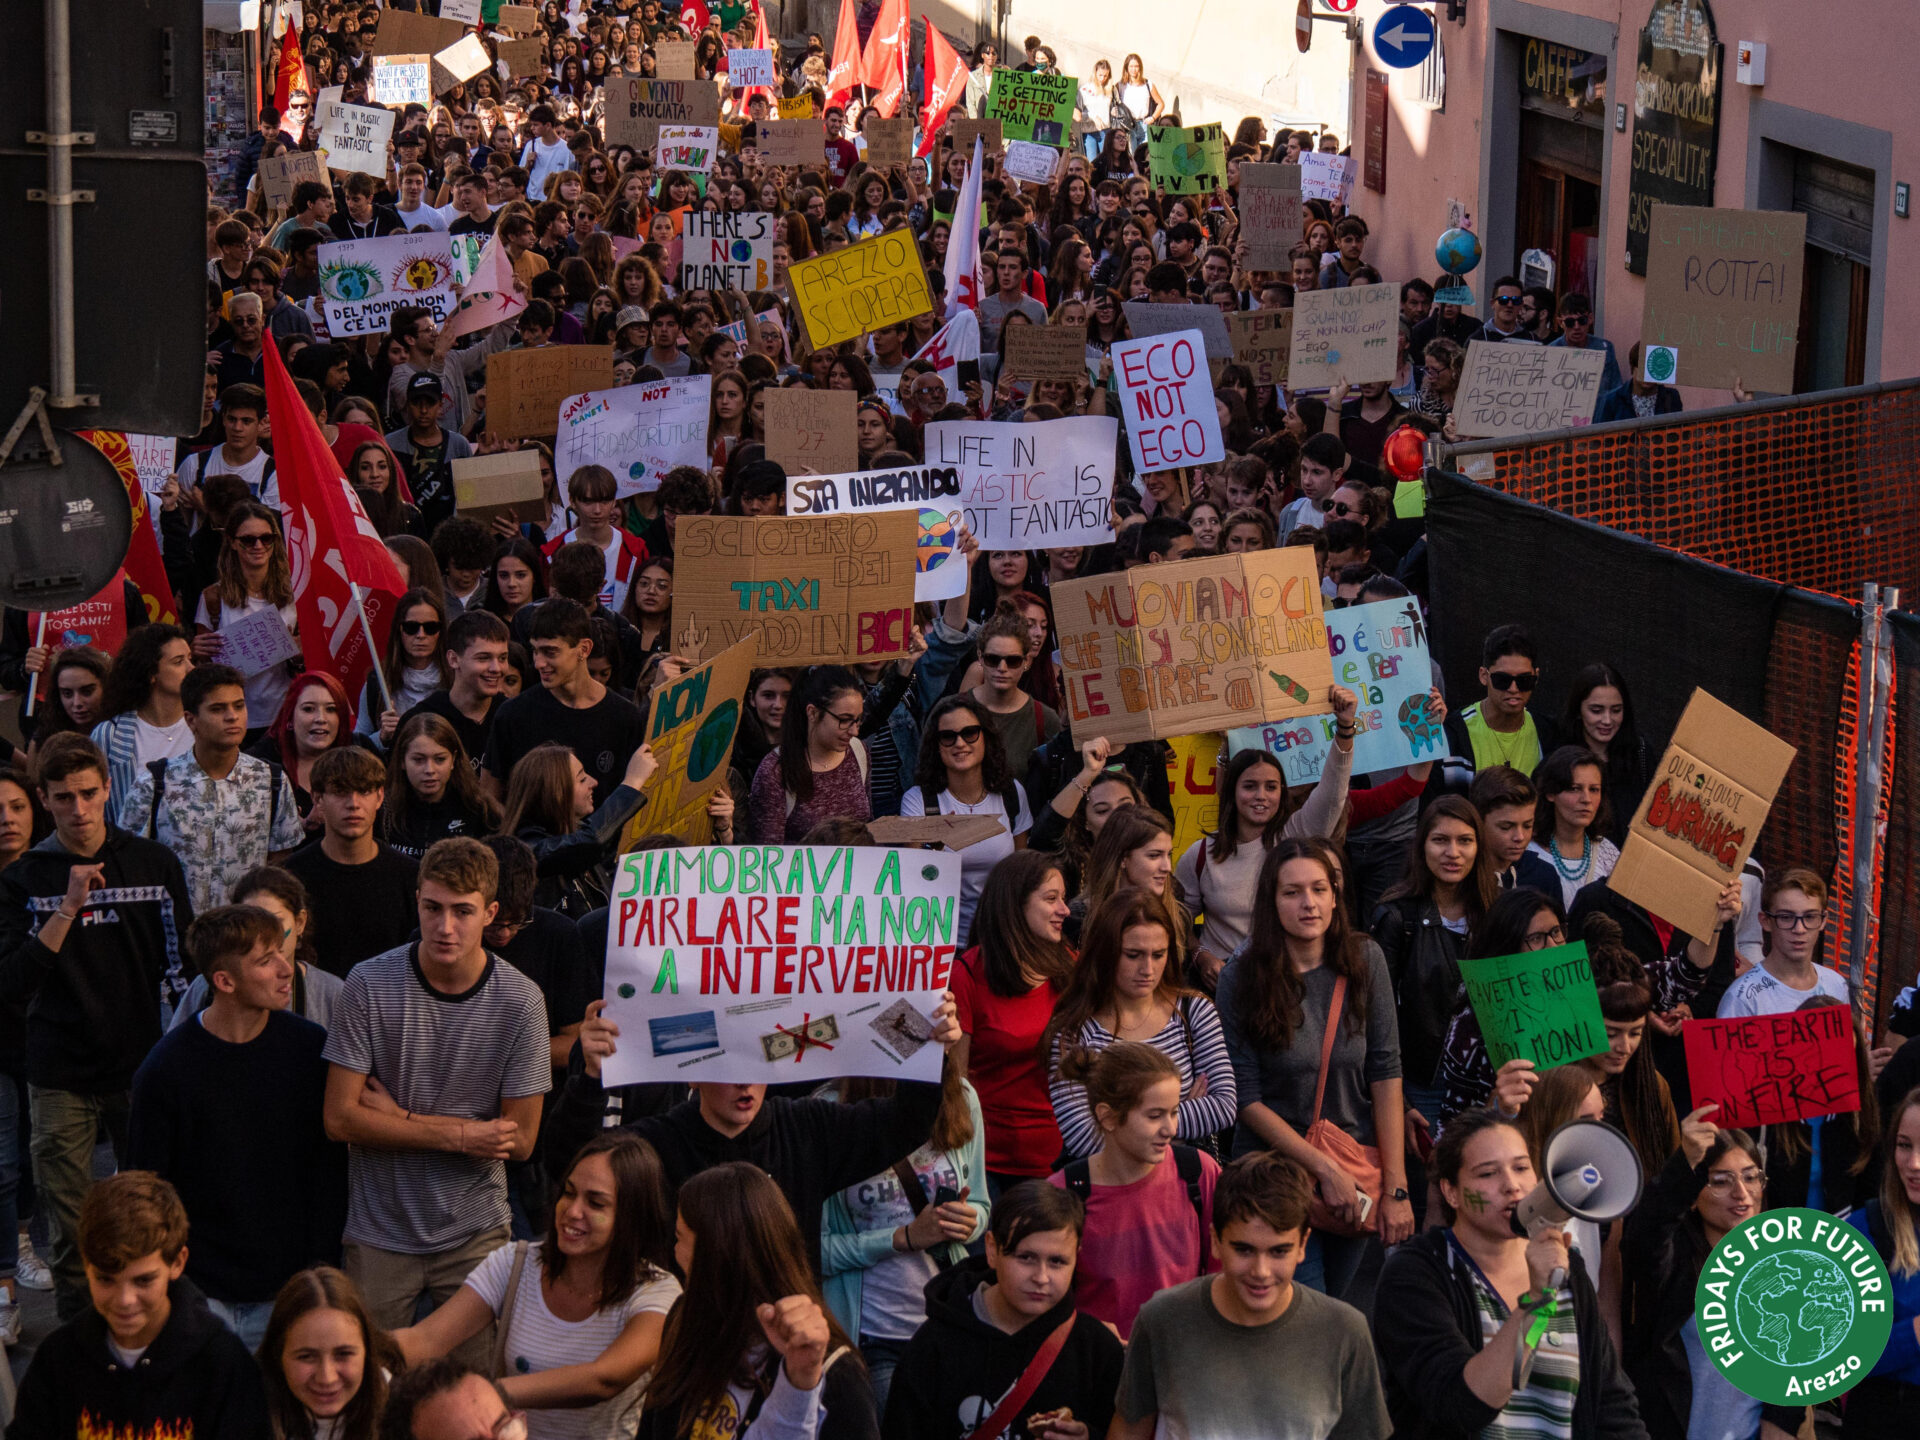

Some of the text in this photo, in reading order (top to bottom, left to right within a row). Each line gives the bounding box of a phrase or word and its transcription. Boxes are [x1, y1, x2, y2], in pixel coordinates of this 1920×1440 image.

[376, 78, 392, 88] THE
[740, 66, 758, 85] HOT
[994, 71, 1068, 88] THIS WORLD
[778, 93, 811, 111] THIS ISN'T
[998, 84, 1066, 104] IS GETTING
[330, 106, 380, 126] LIFE IN PLASTIC
[630, 102, 693, 120] BRUCIATA?
[992, 108, 1030, 126] THAN
[998, 97, 1054, 118] HOTTER
[344, 122, 372, 138] IS NOT
[334, 134, 372, 154] FANTASTIC
[662, 146, 710, 168] POLMONI
[1302, 154, 1343, 168] Ama la
[1302, 178, 1325, 186] come
[1328, 168, 1354, 184] TERRA
[404, 236, 424, 245] 2030
[684, 258, 768, 291] PLANET B
[801, 239, 905, 300] AREZZO
[1685, 256, 1785, 304] ROTTA!
[334, 294, 446, 320] DEL MONDO NON
[810, 272, 930, 346] SCIOPERA
[1302, 296, 1320, 313] SE
[1333, 290, 1362, 306] NON
[369, 305, 447, 330] LA B
[1306, 310, 1363, 326] QUANDO?
[1296, 330, 1311, 342] SE
[1316, 326, 1338, 338] NON
[1362, 320, 1386, 333] CHI?
[1120, 338, 1196, 388] ECO
[1240, 348, 1290, 363] NOSTR
[1480, 350, 1548, 368] ASCOLTA
[1557, 354, 1576, 370] IL
[1476, 366, 1598, 391] PIANETA COME
[564, 392, 591, 421] SAVE
[642, 386, 688, 402] NOT THE
[1136, 381, 1187, 421] NOT
[1467, 388, 1582, 408] ASCOLTI IL
[570, 400, 610, 428] PLANET!
[1472, 408, 1574, 430] TUO CUORE
[797, 430, 825, 450] 27
[940, 430, 1035, 468] LIFE IN
[1138, 420, 1206, 468] EGO
[1074, 464, 1102, 496] IS
[793, 478, 838, 514] STA
[963, 507, 998, 538] OT
[682, 516, 878, 558] SCIOPERO
[834, 551, 891, 588] DEI
[731, 577, 820, 612] TAXI
[1085, 573, 1314, 628] MUOVIAMOCI
[46, 615, 111, 630] TOSCANI!!
[812, 613, 850, 656] IN
[857, 608, 912, 656] BICI
[1061, 631, 1103, 671] CHE
[1115, 628, 1144, 666] MI
[1150, 628, 1172, 666] SI
[1180, 617, 1328, 666] SCONGELANO
[1343, 652, 1402, 683] e Per
[652, 666, 712, 738] NON
[1069, 663, 1218, 722] LE BIRRE
[1359, 682, 1384, 706] la
[1262, 727, 1314, 755] Pena
[1668, 756, 1744, 814] OUR HOUSE
[618, 846, 902, 898] SIAMO BRAVI A
[82, 911, 120, 926] FILA
[618, 896, 954, 947] PARLARE MA NON
[651, 945, 956, 994] A INTERVENIRE
[1542, 958, 1591, 993] ROTTO
[1510, 1008, 1525, 1034] I
[1702, 1010, 1844, 1050] THE EARTH
[1760, 1050, 1796, 1079] IS
[1701, 1064, 1860, 1123] ON FIRE
